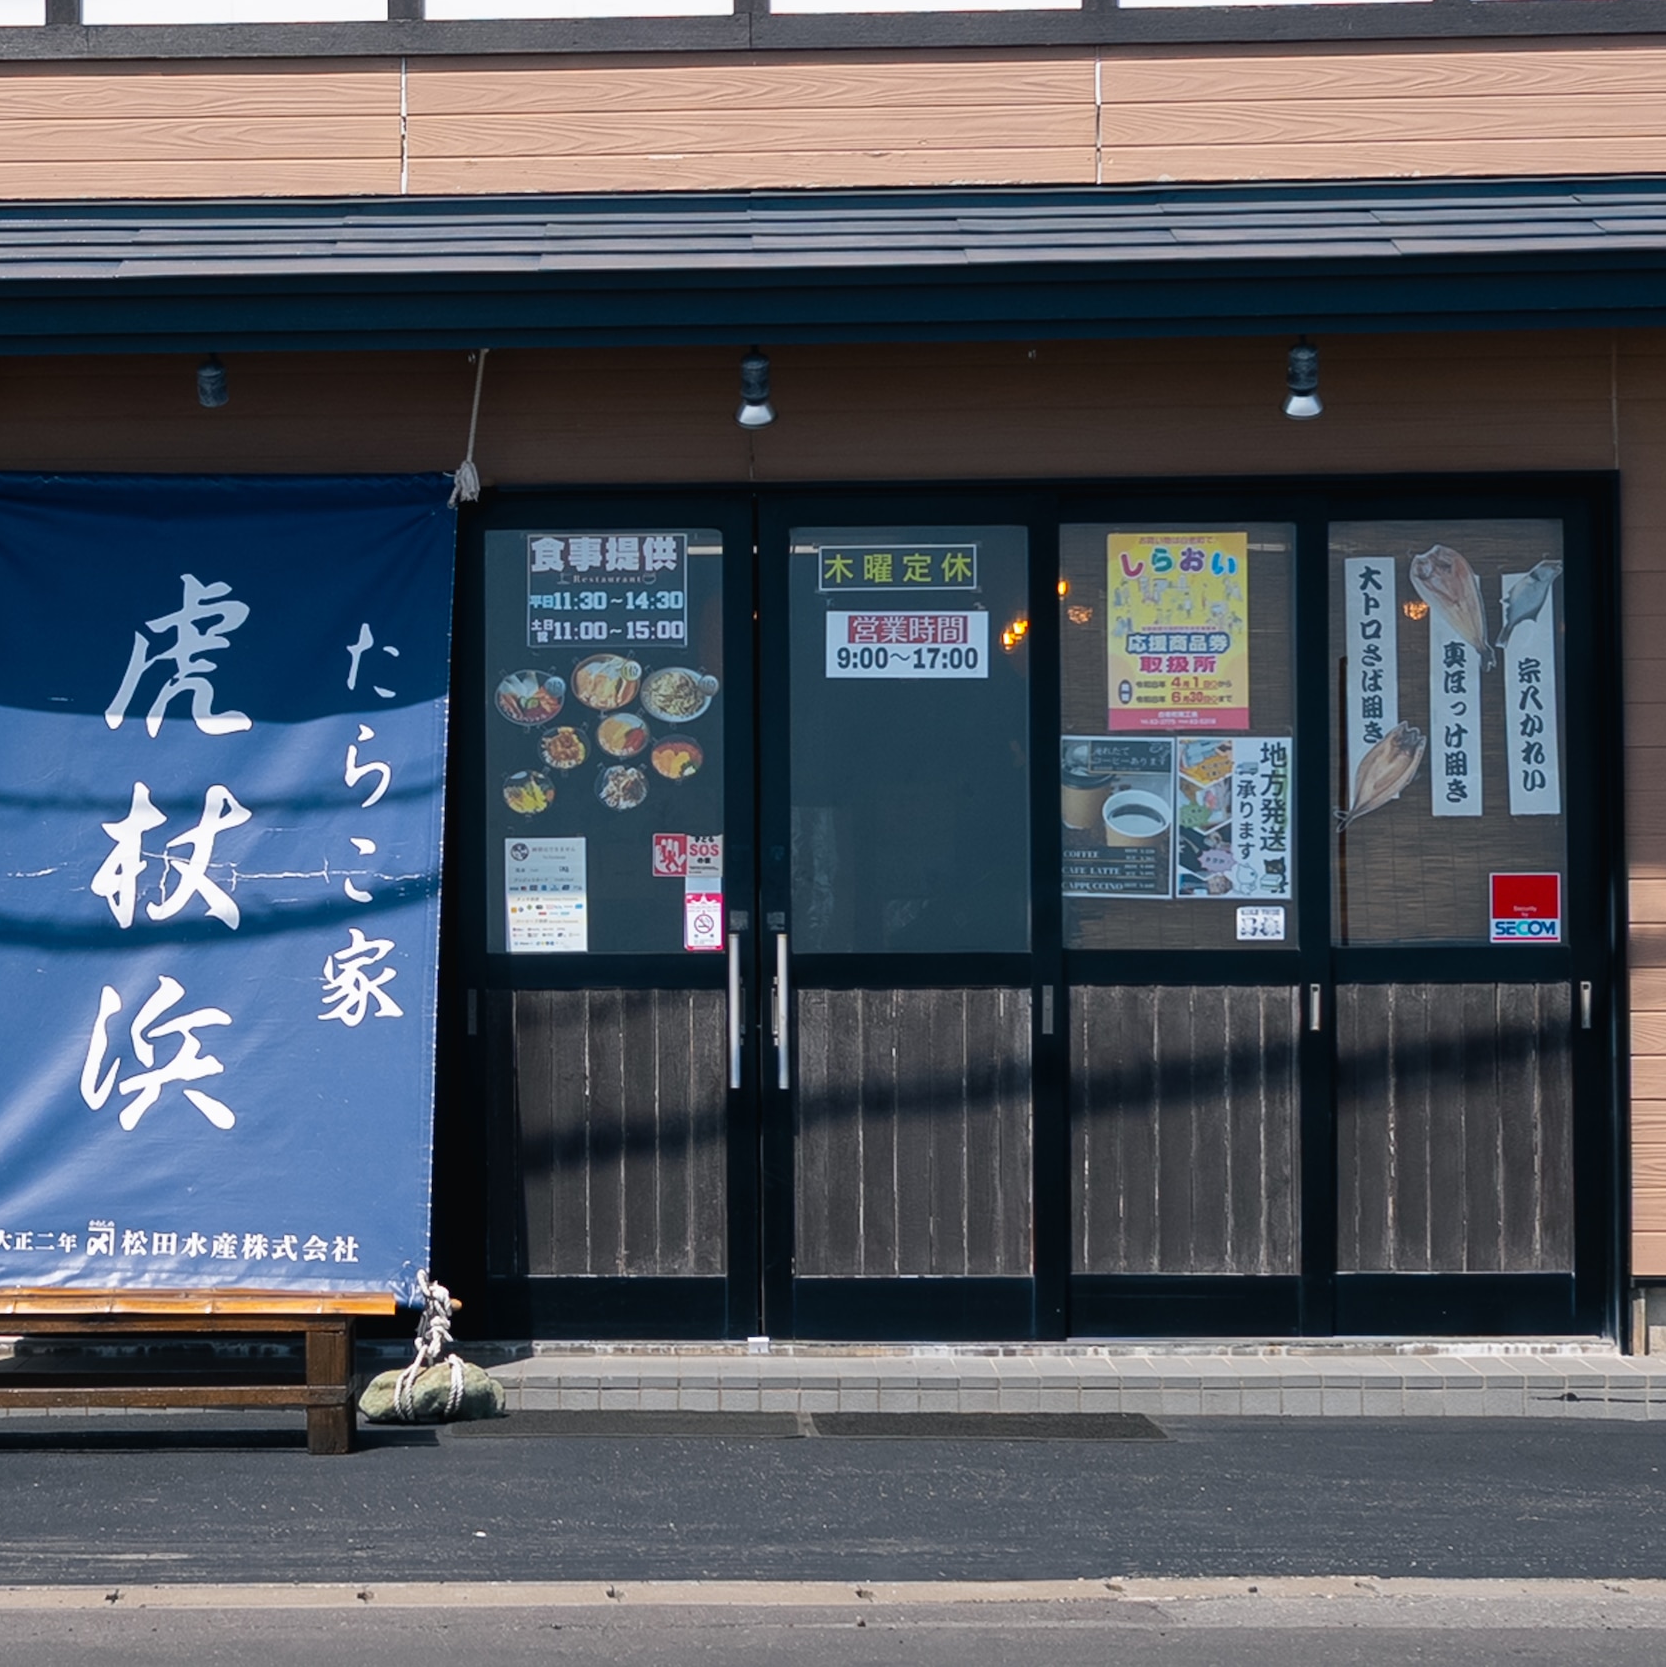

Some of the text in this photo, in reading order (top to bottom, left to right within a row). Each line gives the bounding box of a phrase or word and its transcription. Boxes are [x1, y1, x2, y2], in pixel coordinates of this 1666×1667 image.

[531, 536, 677, 572] 食事提供
[824, 553, 972, 583] 木曜定休
[1120, 546, 1237, 578] しらおい
[573, 574, 641, 584] Restaurant
[851, 616, 965, 643] 営業時間
[1128, 634, 1229, 653] 応援商品券
[1139, 655, 1217, 674] 取扱所
[1358, 565, 1383, 745] 大トロさば開き
[1443, 641, 1469, 803] 真ほっけ開き
[1517, 658, 1546, 792] 宗八かれい
[1259, 741, 1287, 852] 地方発送
[317, 622, 402, 1027] たらこ家
[1236, 779, 1256, 860] 承ります
[79, 574, 252, 1131] 虎杖浜
[689, 844, 719, 856] SOS
[1495, 920, 1556, 935] SECOM
[120, 1229, 360, 1264] 松田水産株式会社
